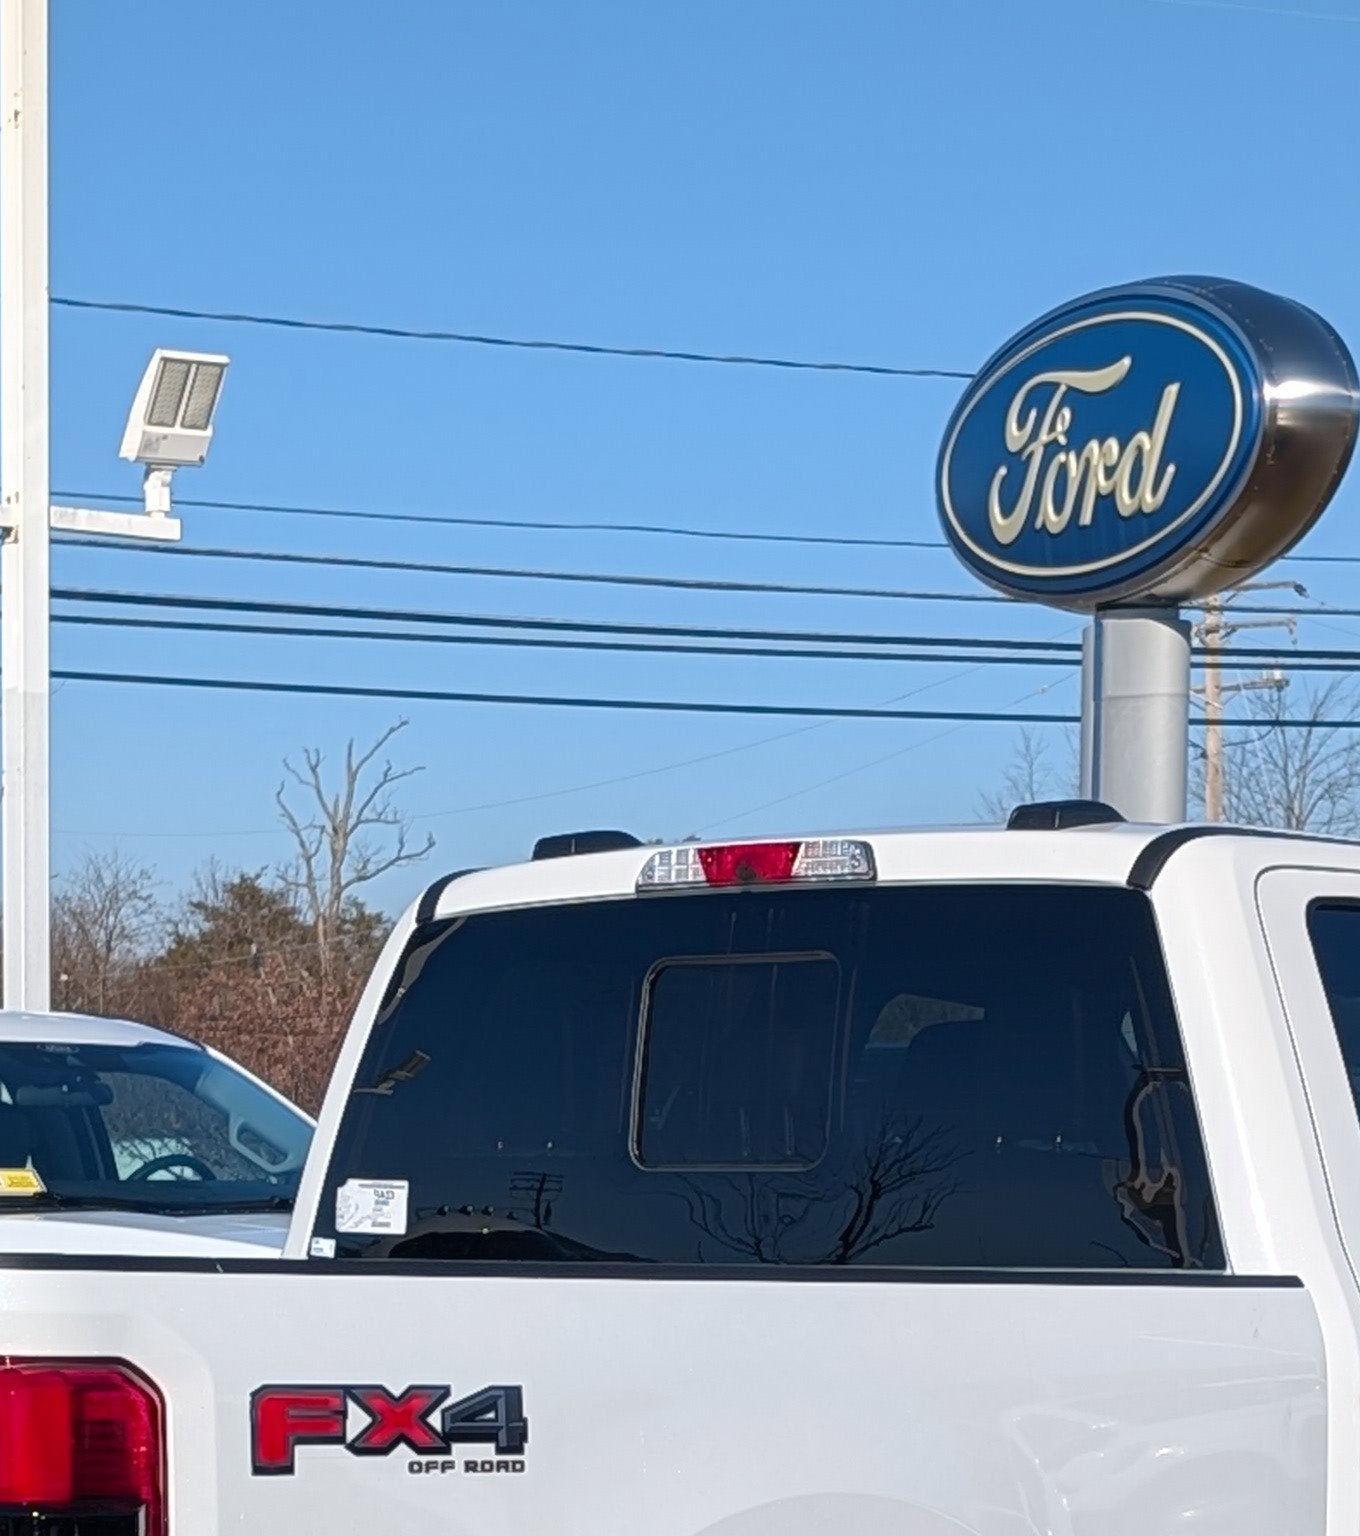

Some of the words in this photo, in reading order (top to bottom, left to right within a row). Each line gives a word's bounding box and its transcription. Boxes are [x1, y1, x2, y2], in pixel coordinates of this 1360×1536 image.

[988, 354, 1181, 546] Ford
[249, 1384, 529, 1477] FX4
[407, 1459, 456, 1475] OFF
[463, 1459, 526, 1475] ROAD
